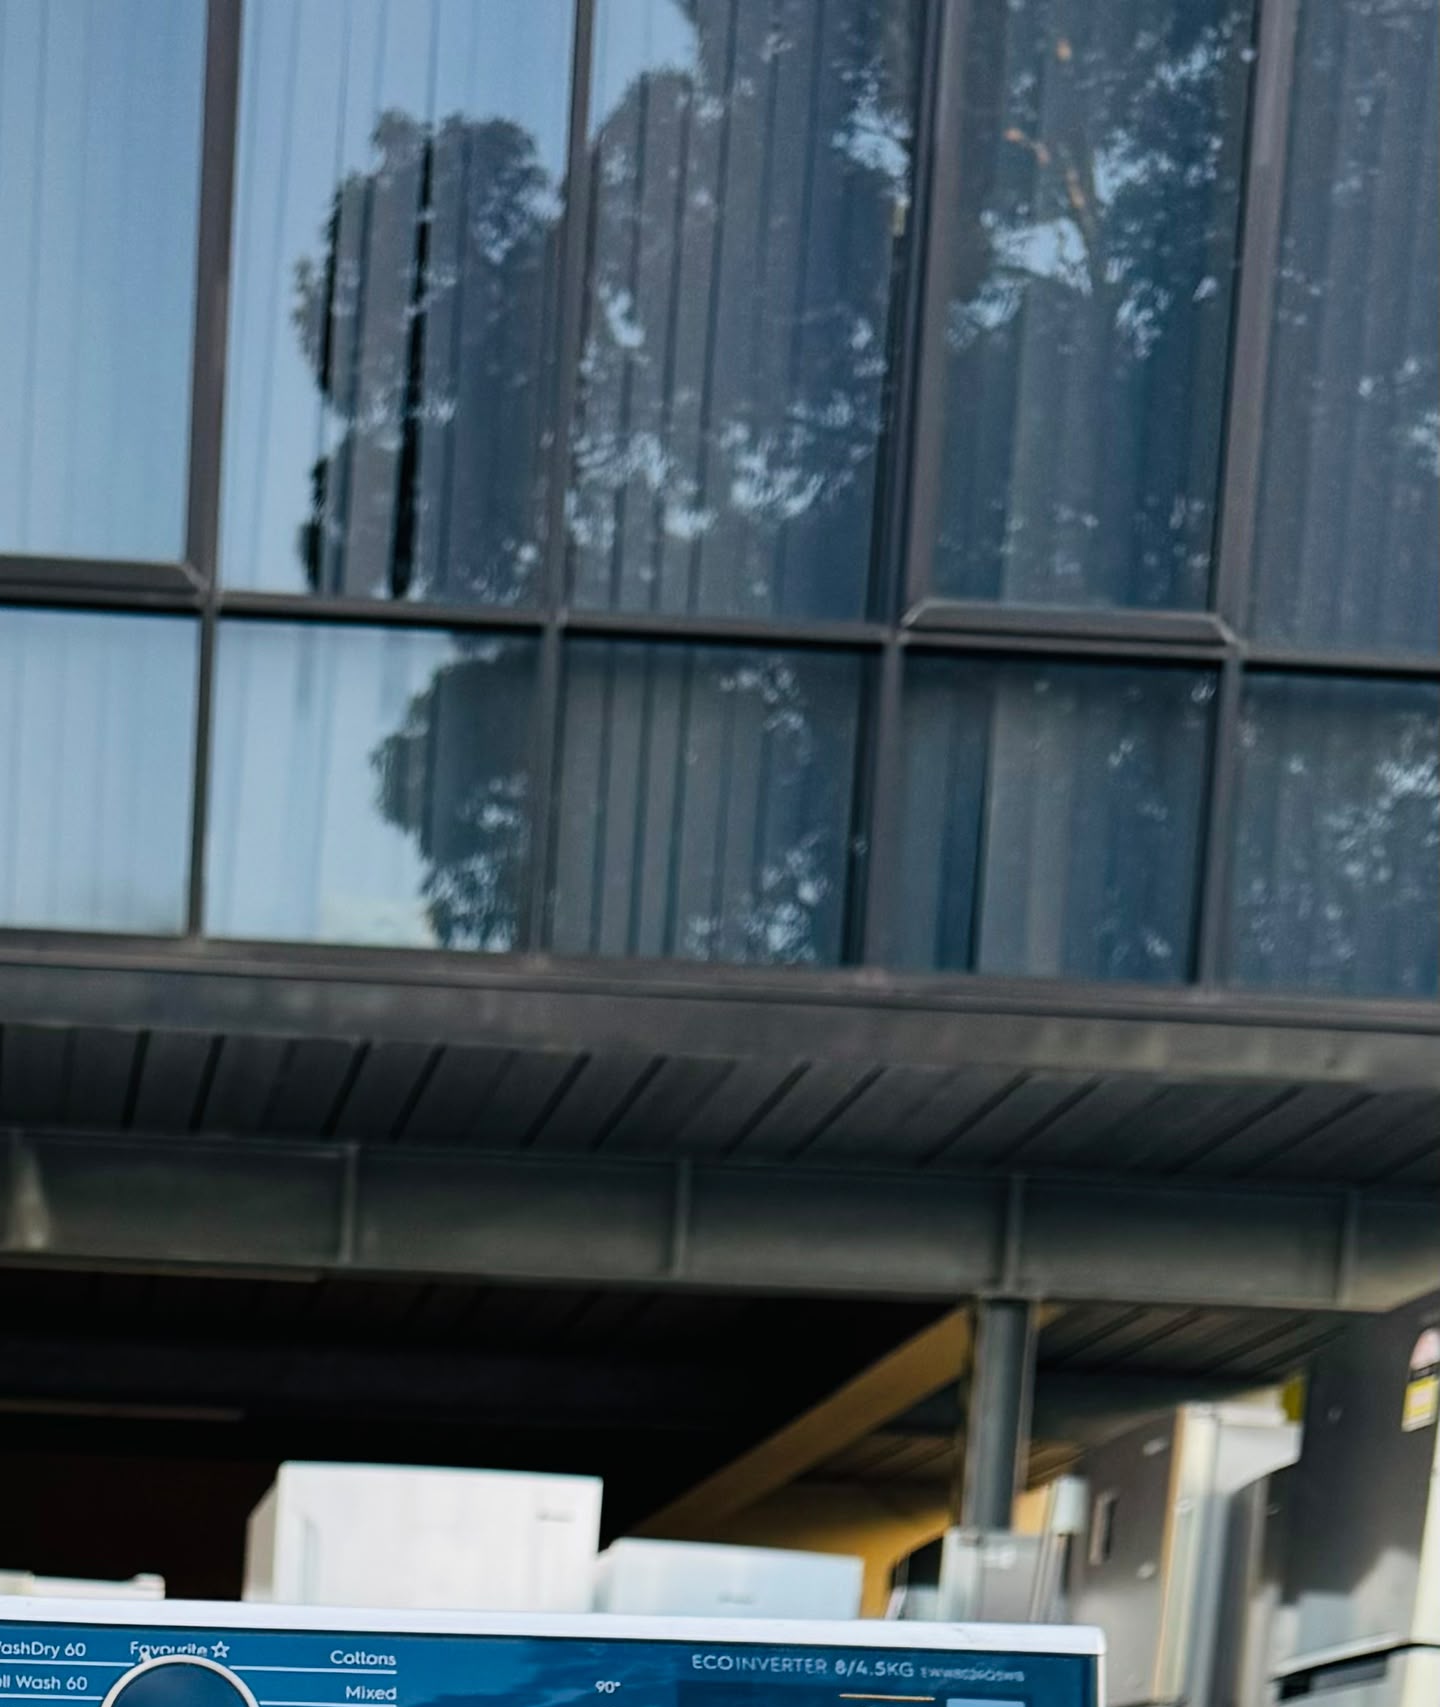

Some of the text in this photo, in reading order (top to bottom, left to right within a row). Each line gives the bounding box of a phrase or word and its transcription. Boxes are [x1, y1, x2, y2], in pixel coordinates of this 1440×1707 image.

[64, 1643, 86, 1656] 60
[330, 1650, 396, 1666] Cottons
[835, 1659, 914, 1678] 8/4.5KG
[15, 1675, 61, 1690] Wash
[66, 1677, 88, 1690] 60
[595, 1681, 621, 1694] 90°
[346, 1685, 397, 1700] Mixed
